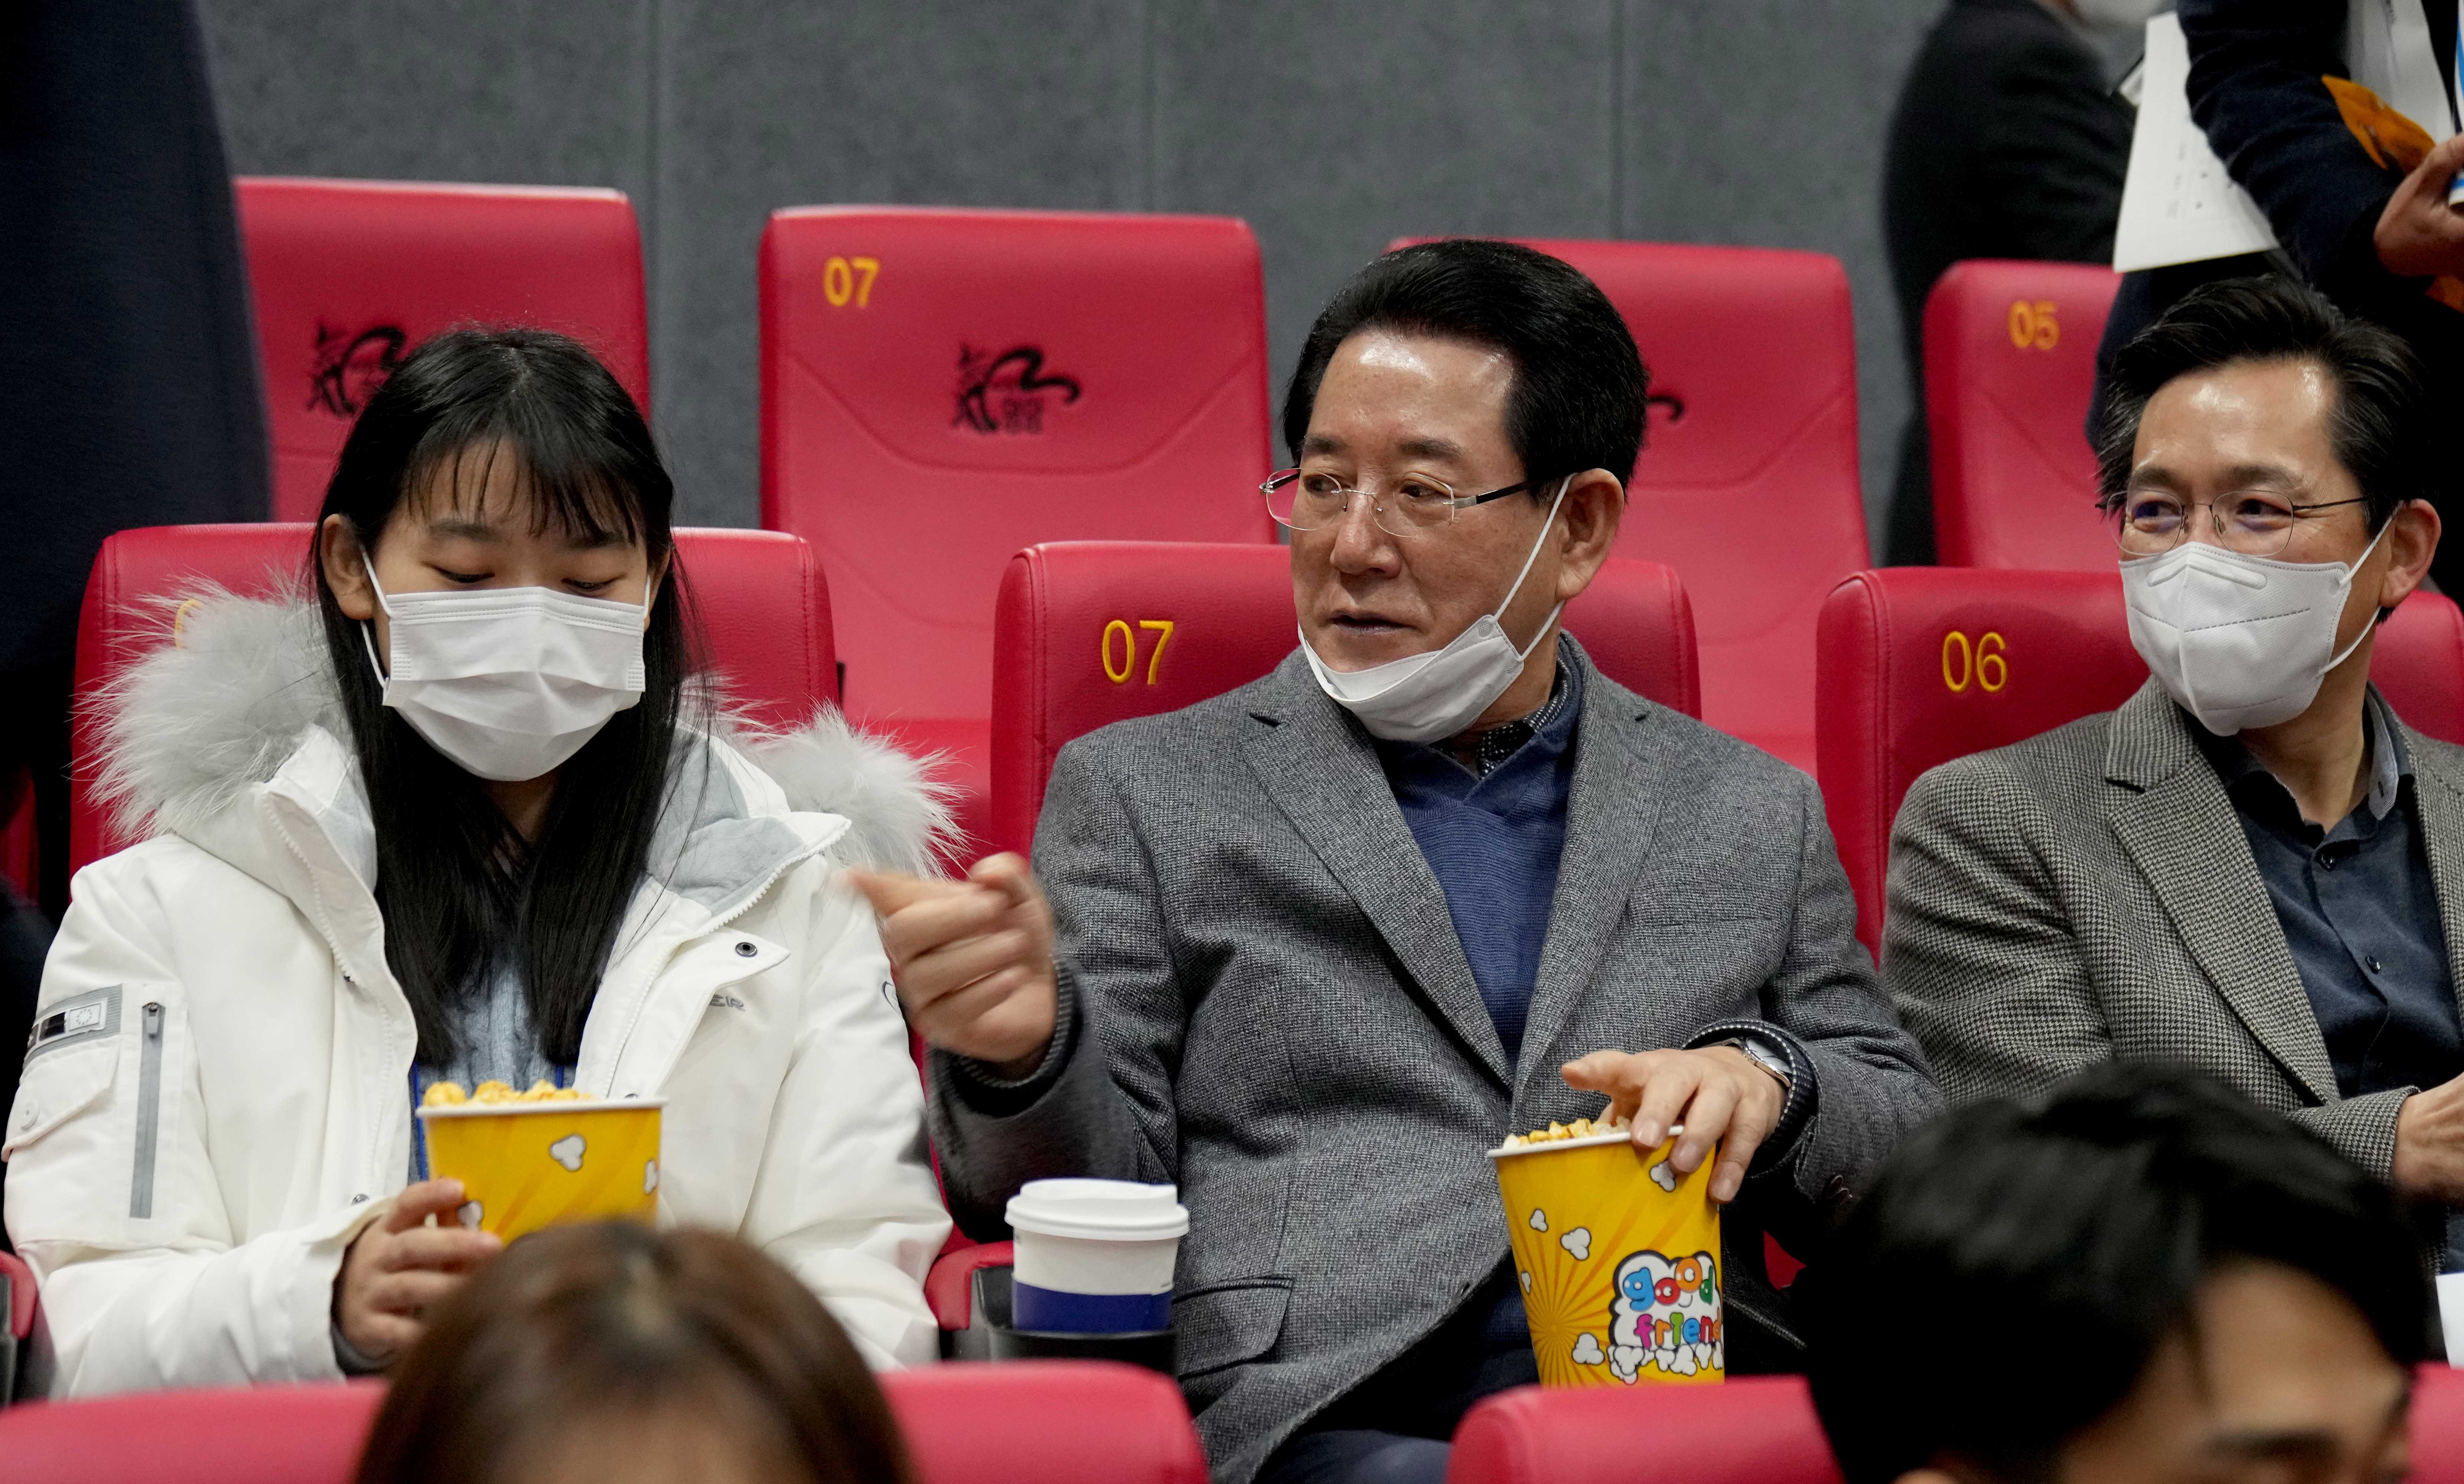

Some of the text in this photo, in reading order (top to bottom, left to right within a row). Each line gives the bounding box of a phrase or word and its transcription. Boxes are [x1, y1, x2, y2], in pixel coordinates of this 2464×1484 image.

[823, 256, 880, 308] 07
[2008, 299, 2060, 350] 05
[1102, 619, 1174, 685] 07
[1943, 631, 2007, 692] 06
[1623, 1257, 1714, 1312] good
[1634, 1306, 1722, 1349] friend
